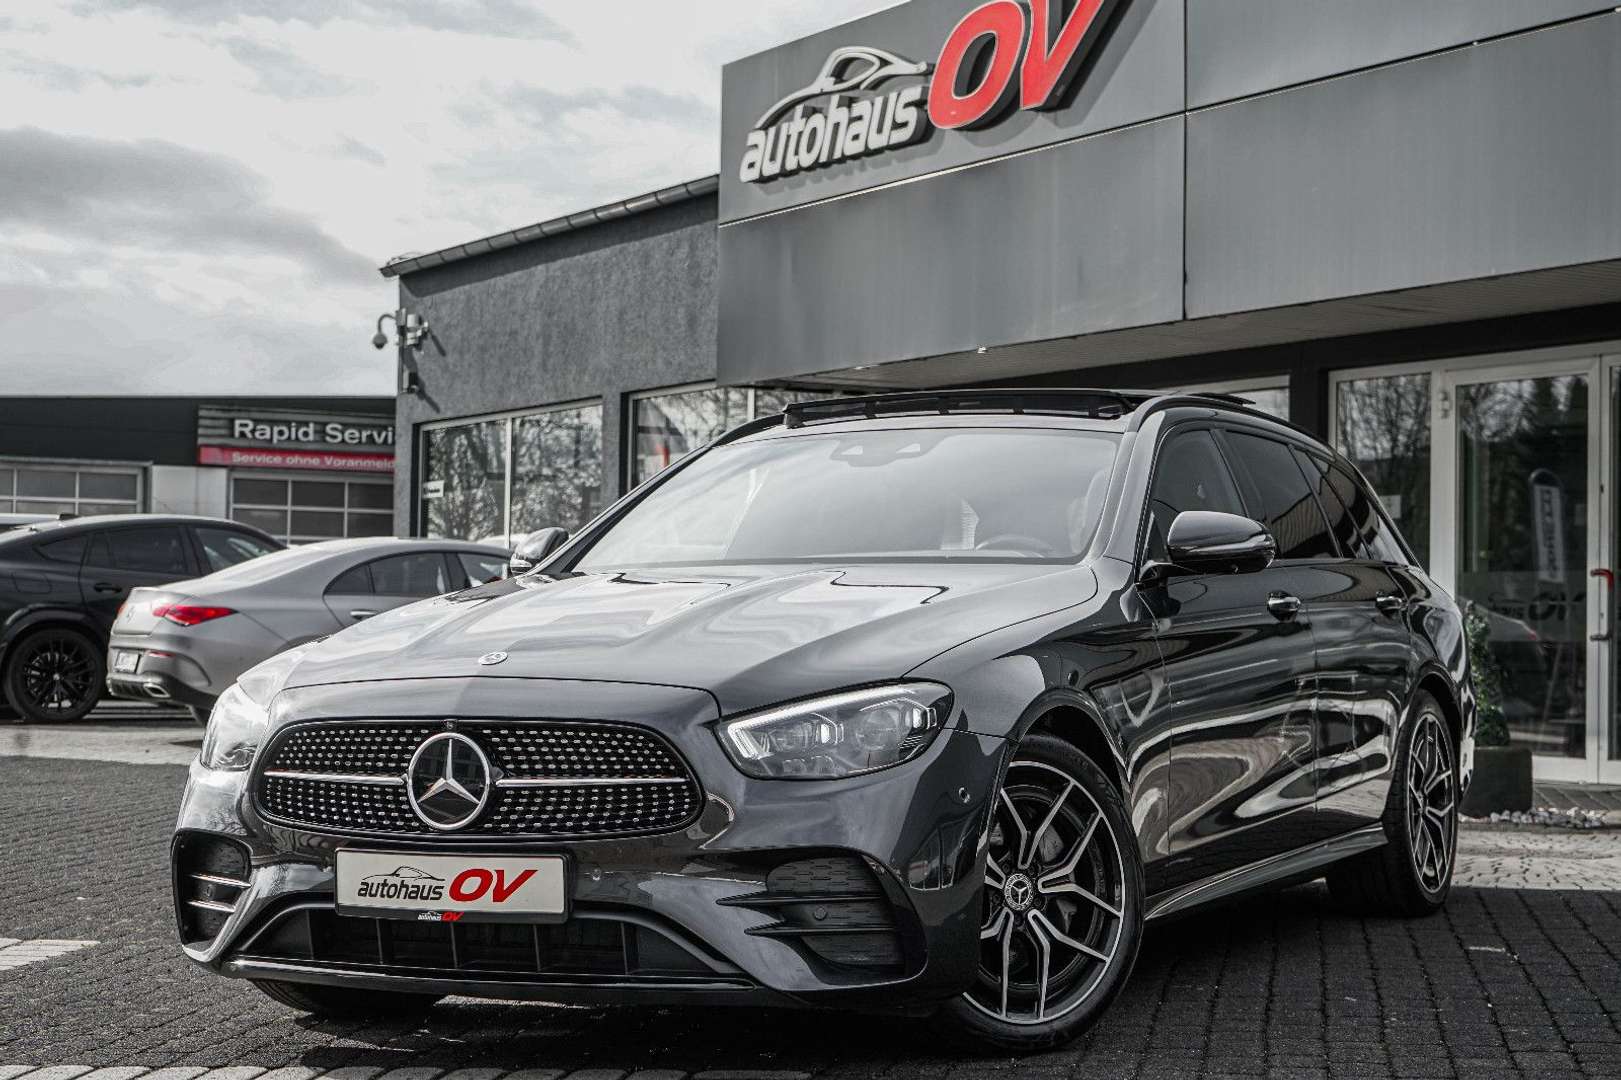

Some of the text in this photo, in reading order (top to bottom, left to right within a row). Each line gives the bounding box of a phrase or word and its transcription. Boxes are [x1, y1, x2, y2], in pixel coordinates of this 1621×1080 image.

[740, 0, 1103, 183] autohaus OV
[234, 419, 315, 444] Rapid
[232, 451, 283, 465] Service
[286, 456, 320, 467] ohne
[357, 868, 539, 903] autohaus OV
[442, 911, 465, 921] OV
